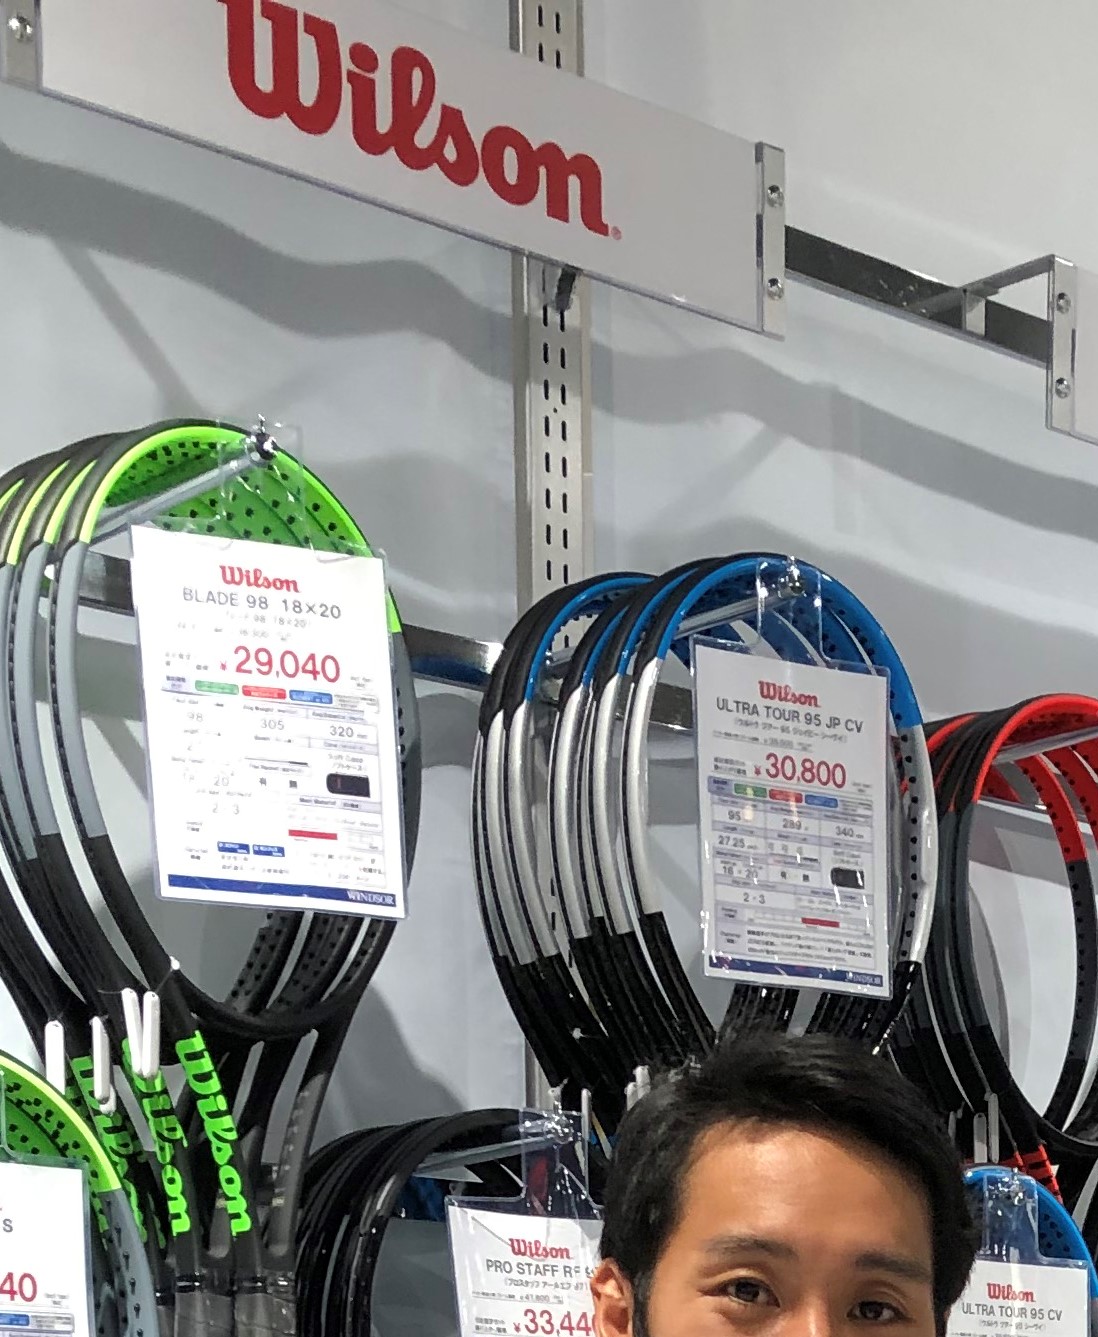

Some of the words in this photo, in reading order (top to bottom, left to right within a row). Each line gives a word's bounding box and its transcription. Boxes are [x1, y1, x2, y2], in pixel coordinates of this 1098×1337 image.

[217, 0, 611, 237] Wilson
[219, 565, 301, 593] Wilson
[183, 587, 240, 608] BLADE
[246, 596, 269, 610] 98
[757, 680, 822, 708] Wilson
[716, 696, 760, 717] ULTRA
[764, 705, 800, 724] TOUR
[804, 713, 822, 727] 95
[825, 716, 841, 731] JP
[844, 718, 864, 734] CV
[329, 724, 355, 738] 320
[836, 826, 854, 838] 340
[346, 889, 396, 907] WINDSOR
[174, 1030, 252, 1238] Wilson
[508, 1237, 574, 1260] Wilson
[486, 1259, 513, 1274] PRO
[516, 1262, 559, 1278] STAFF
[987, 1282, 1036, 1303] Wilson
[513, 1308, 594, 1337] ¥33,44
[962, 1302, 996, 1317] ULTRA
[999, 1305, 1027, 1318] TOUR
[1030, 1308, 1044, 1320] 95
[1047, 1310, 1063, 1321] CV
